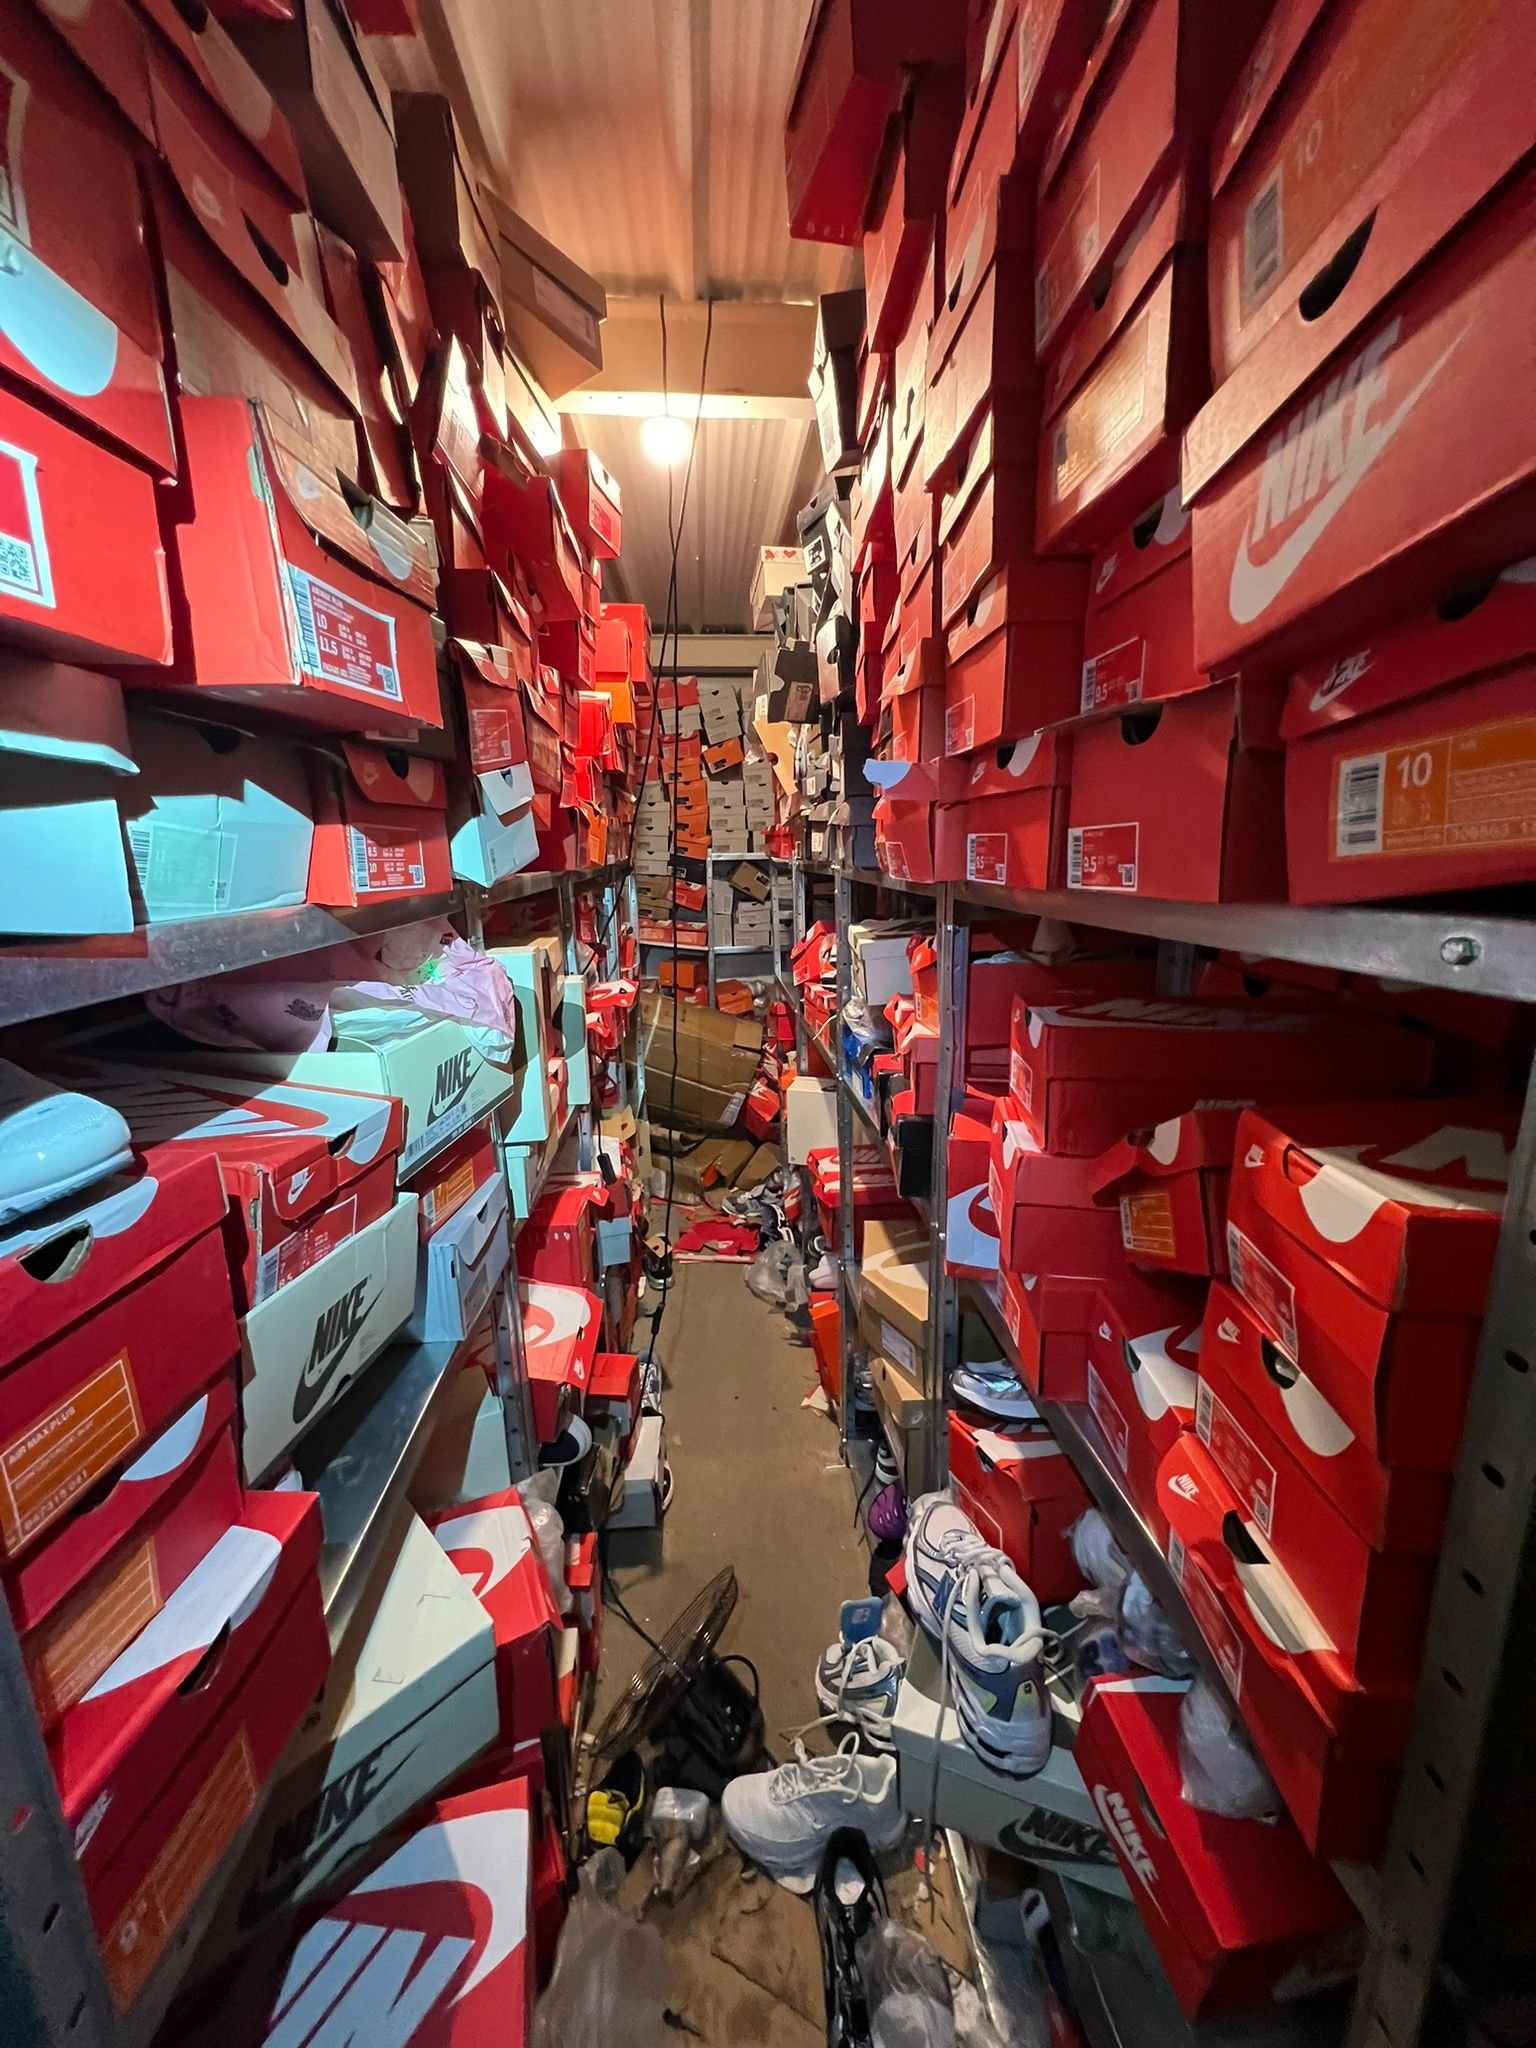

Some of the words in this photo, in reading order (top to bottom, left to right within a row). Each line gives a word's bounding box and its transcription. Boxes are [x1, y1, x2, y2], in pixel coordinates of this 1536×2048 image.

[1252, 315, 1400, 543] NIKE
[316, 612, 328, 630] 10
[319, 635, 338, 656] 11.5
[1399, 752, 1432, 788] 10
[435, 1046, 472, 1107] NIKE
[307, 1276, 368, 1375] NIKE
[1177, 1473, 1200, 1498] NIKE
[1107, 1791, 1160, 1885] NIKE
